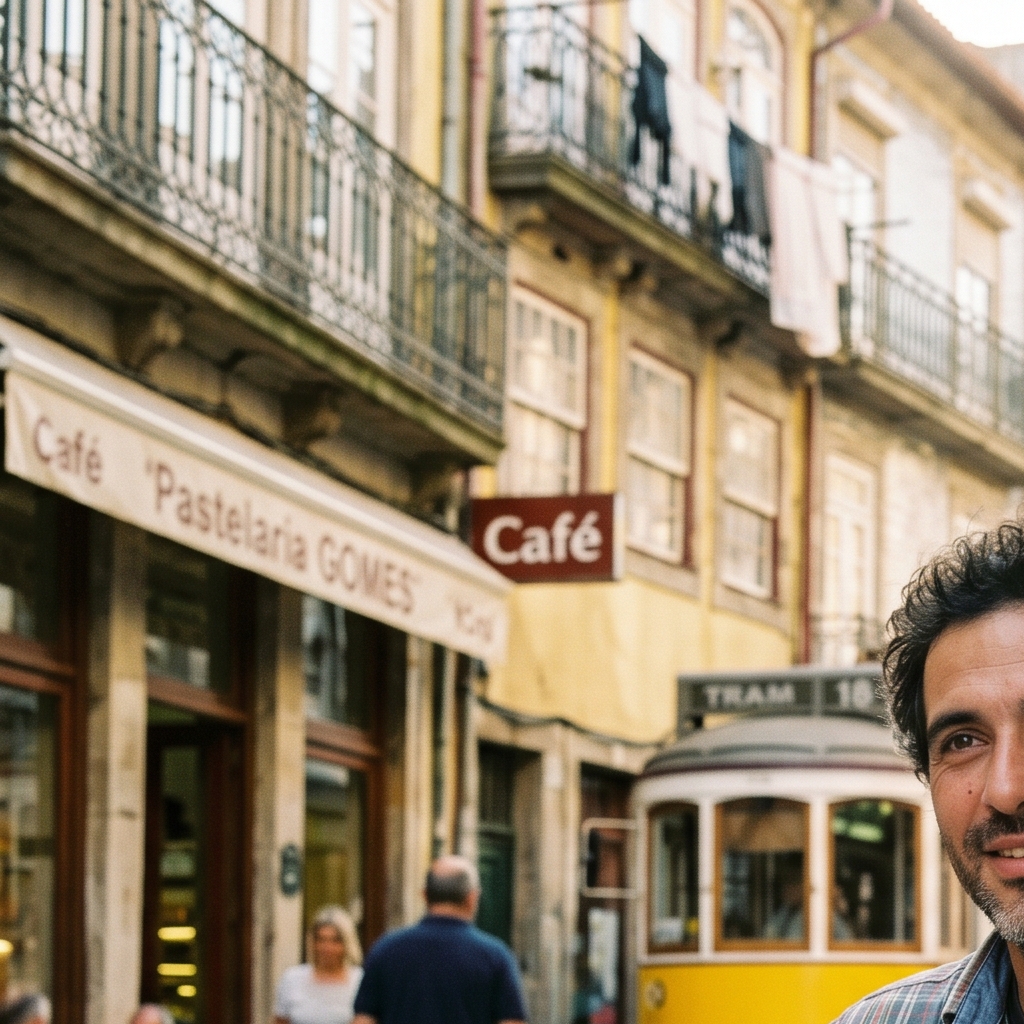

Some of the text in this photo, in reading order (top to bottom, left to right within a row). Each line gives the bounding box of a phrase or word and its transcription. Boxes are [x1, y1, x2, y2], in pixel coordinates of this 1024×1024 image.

[32, 415, 102, 486] Café
[482, 511, 604, 566] Café
[702, 683, 796, 709] TRAM
